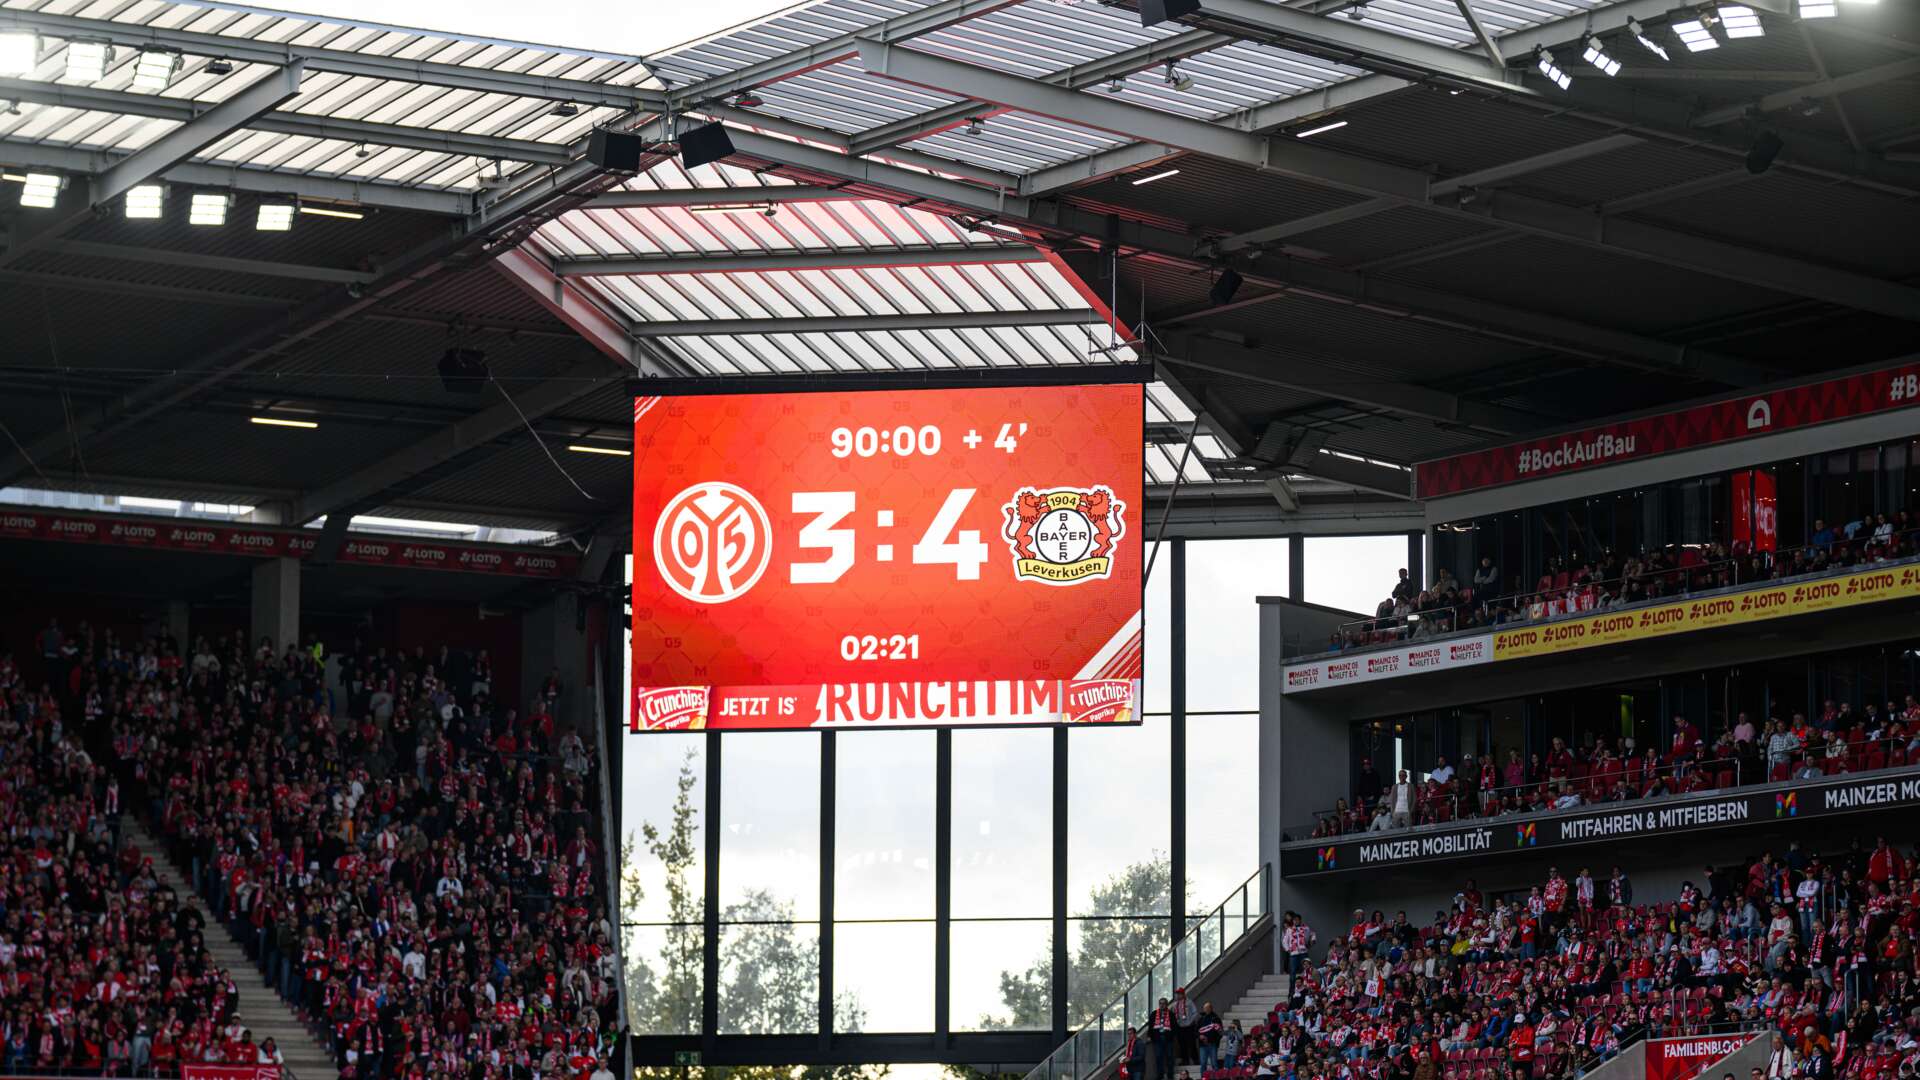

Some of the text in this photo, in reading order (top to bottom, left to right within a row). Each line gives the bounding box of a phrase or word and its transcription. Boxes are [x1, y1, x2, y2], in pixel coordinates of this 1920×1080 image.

[830, 425, 941, 459] 90:00
[962, 429, 983, 450] +
[1518, 434, 1636, 474] #BockAufBau
[1050, 495, 1077, 507] 1904
[4, 516, 37, 529] LOTTO
[63, 521, 97, 534] LOTTO
[123, 525, 157, 538] LOTTO
[184, 530, 216, 543] LOTTO
[789, 490, 857, 585] 3
[912, 488, 989, 581] 4
[1040, 531, 1087, 542] BAYER
[243, 535, 275, 547] LOTTO
[358, 544, 390, 557] LOTTO
[415, 548, 446, 561] LOTTO
[472, 552, 502, 565] LOTTO
[528, 556, 557, 570] LOTTO
[1024, 561, 1102, 578] Leverkusen
[1860, 574, 1894, 591] LOTTO
[1806, 582, 1840, 601] LOTTO
[1754, 591, 1787, 609] LOTTO
[1702, 599, 1735, 616] LOTTO
[1652, 607, 1684, 625] LOTTO
[1603, 616, 1634, 634] LOTTO
[1555, 624, 1585, 641] LOTTO
[1508, 632, 1537, 648] LOTTO
[840, 634, 920, 662] 02:21
[1415, 650, 1433, 659] MAINZ
[1456, 643, 1475, 653] MAINZ
[1374, 657, 1392, 666] MAINZ
[1414, 657, 1430, 667] HILFT
[1456, 651, 1472, 661] HILFT
[1294, 669, 1313, 678] MAINZ
[1333, 663, 1351, 672] MAINZ
[1374, 664, 1389, 673] HILFT
[1293, 677, 1309, 686] HILFT
[1333, 671, 1348, 680] HILFT
[645, 690, 704, 722] Crunchips
[719, 697, 770, 717] JETZT
[1089, 707, 1115, 722] Paprika
[664, 714, 691, 730] Paprika
[1825, 783, 1897, 809] MAINZER
[1560, 800, 1748, 840] MITFAHREN & MITFIEBERN
[1359, 830, 1493, 864] MAINZER MOBILITÄT
